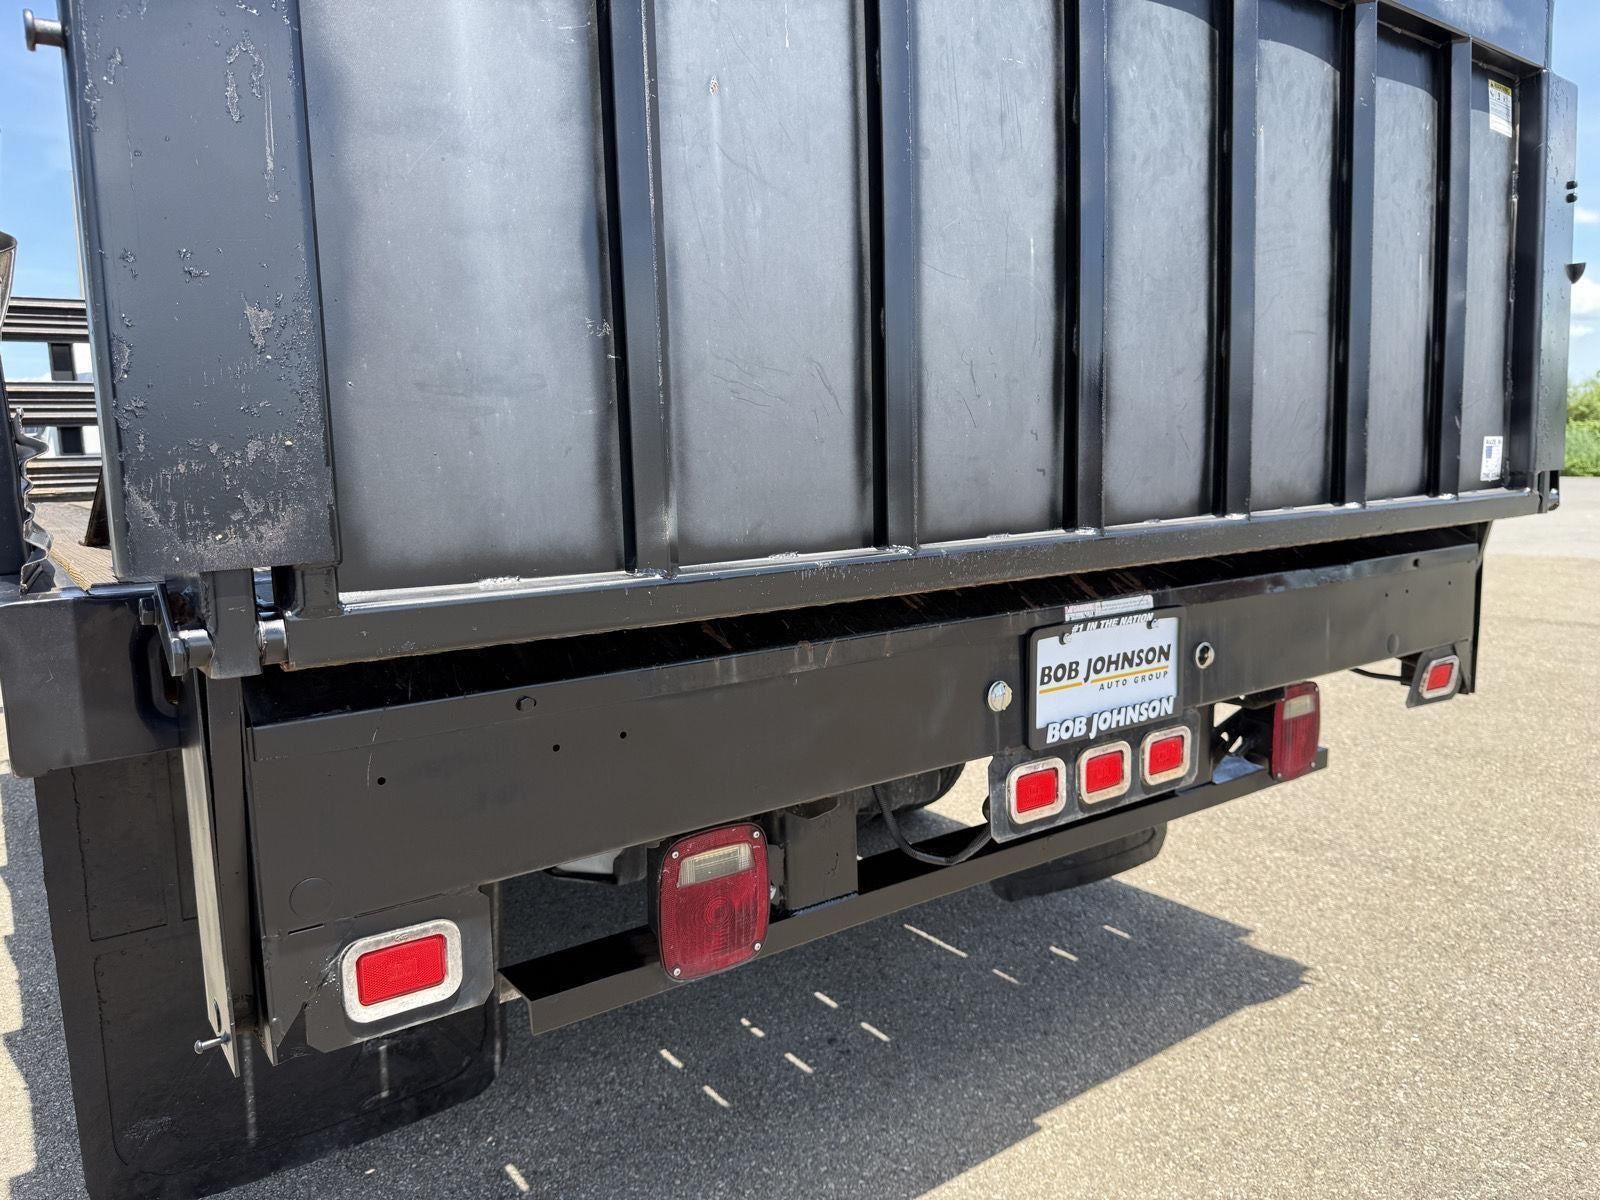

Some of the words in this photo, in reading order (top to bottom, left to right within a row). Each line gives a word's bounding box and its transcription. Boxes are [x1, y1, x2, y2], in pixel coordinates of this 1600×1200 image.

[1072, 623, 1084, 633] #1
[1086, 621, 1098, 631] IN
[1100, 617, 1119, 629] THE
[1119, 612, 1154, 626] NATION
[1039, 660, 1079, 686] BOB
[1083, 644, 1171, 683] JOHNSON
[1098, 678, 1128, 692] AUTO
[1133, 671, 1169, 684] GROUP
[1046, 716, 1087, 744] BOB
[1089, 696, 1174, 739] JOHNSON
